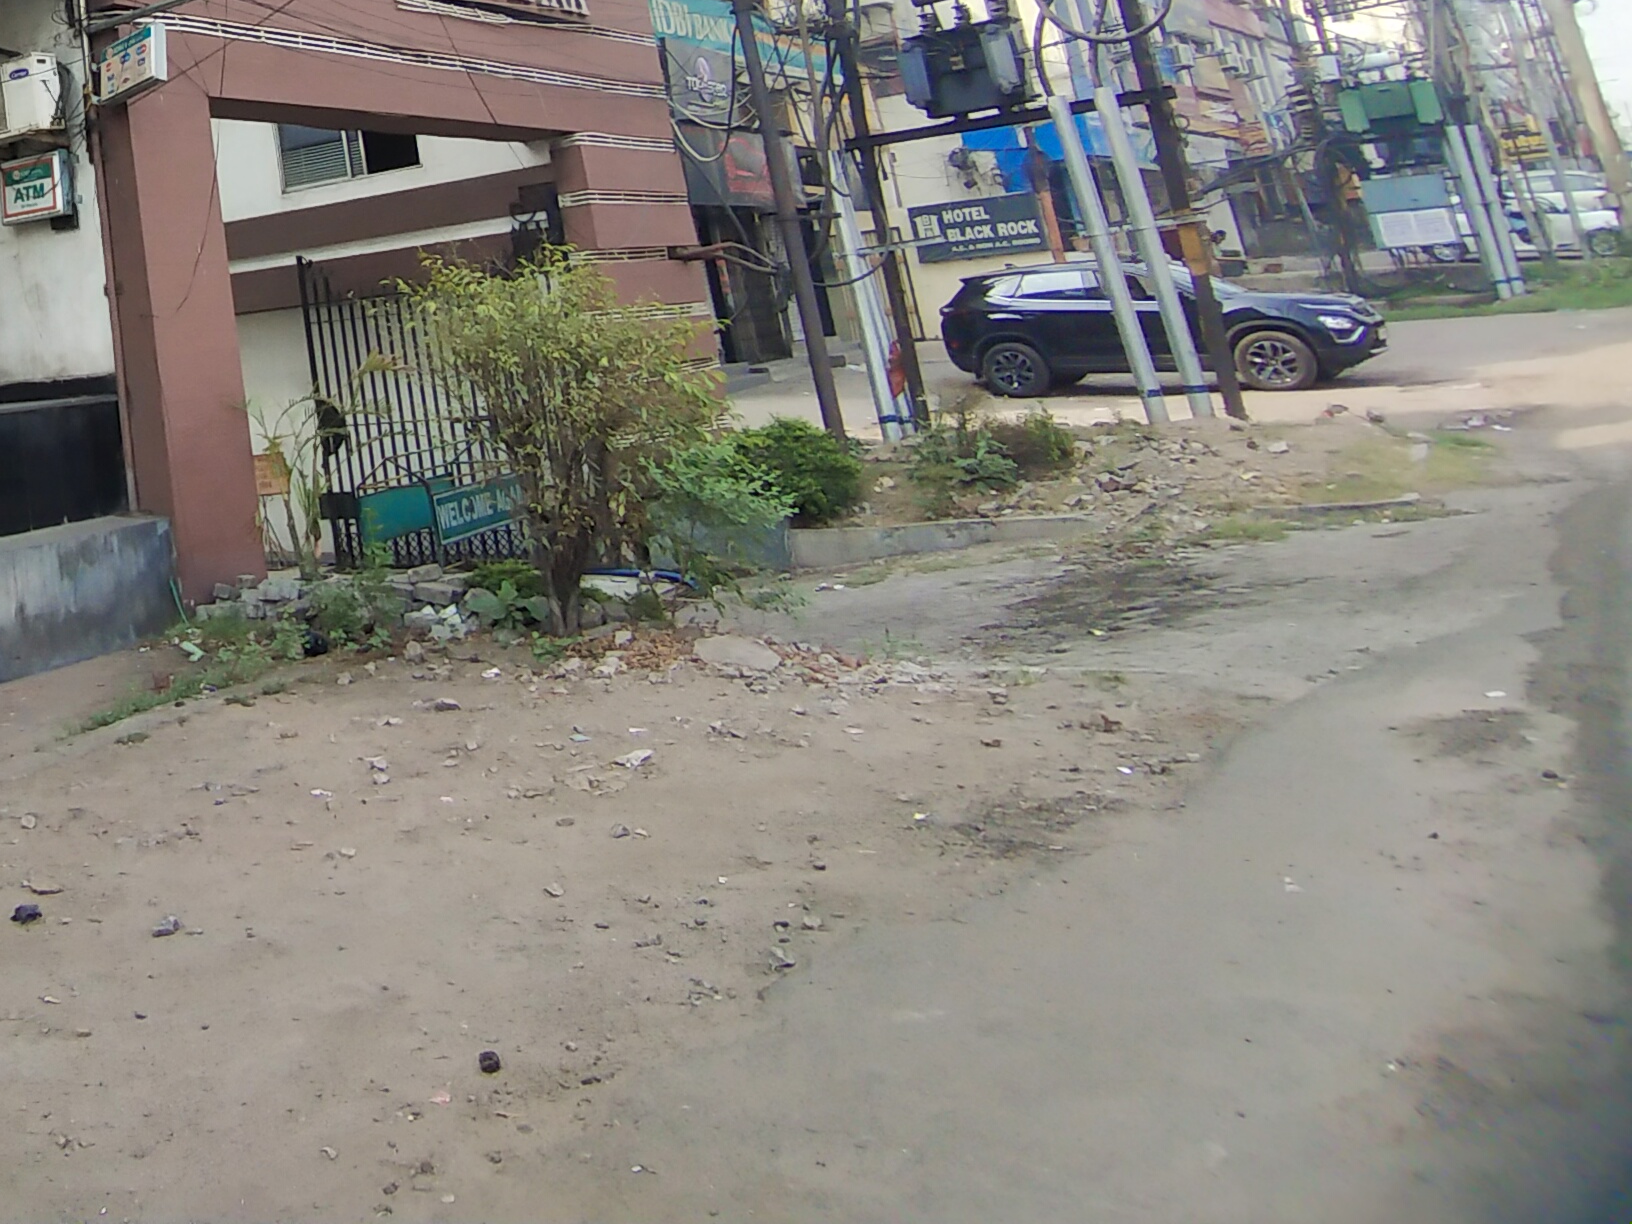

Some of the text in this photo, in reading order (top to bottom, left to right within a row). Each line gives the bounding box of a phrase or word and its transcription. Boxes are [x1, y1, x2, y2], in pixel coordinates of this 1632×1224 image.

[693, 13, 733, 43] BANK
[13, 183, 45, 204] ATM
[941, 206, 990, 224] HOTEL
[946, 224, 995, 242] BLACK
[996, 219, 1039, 237] ROCK
